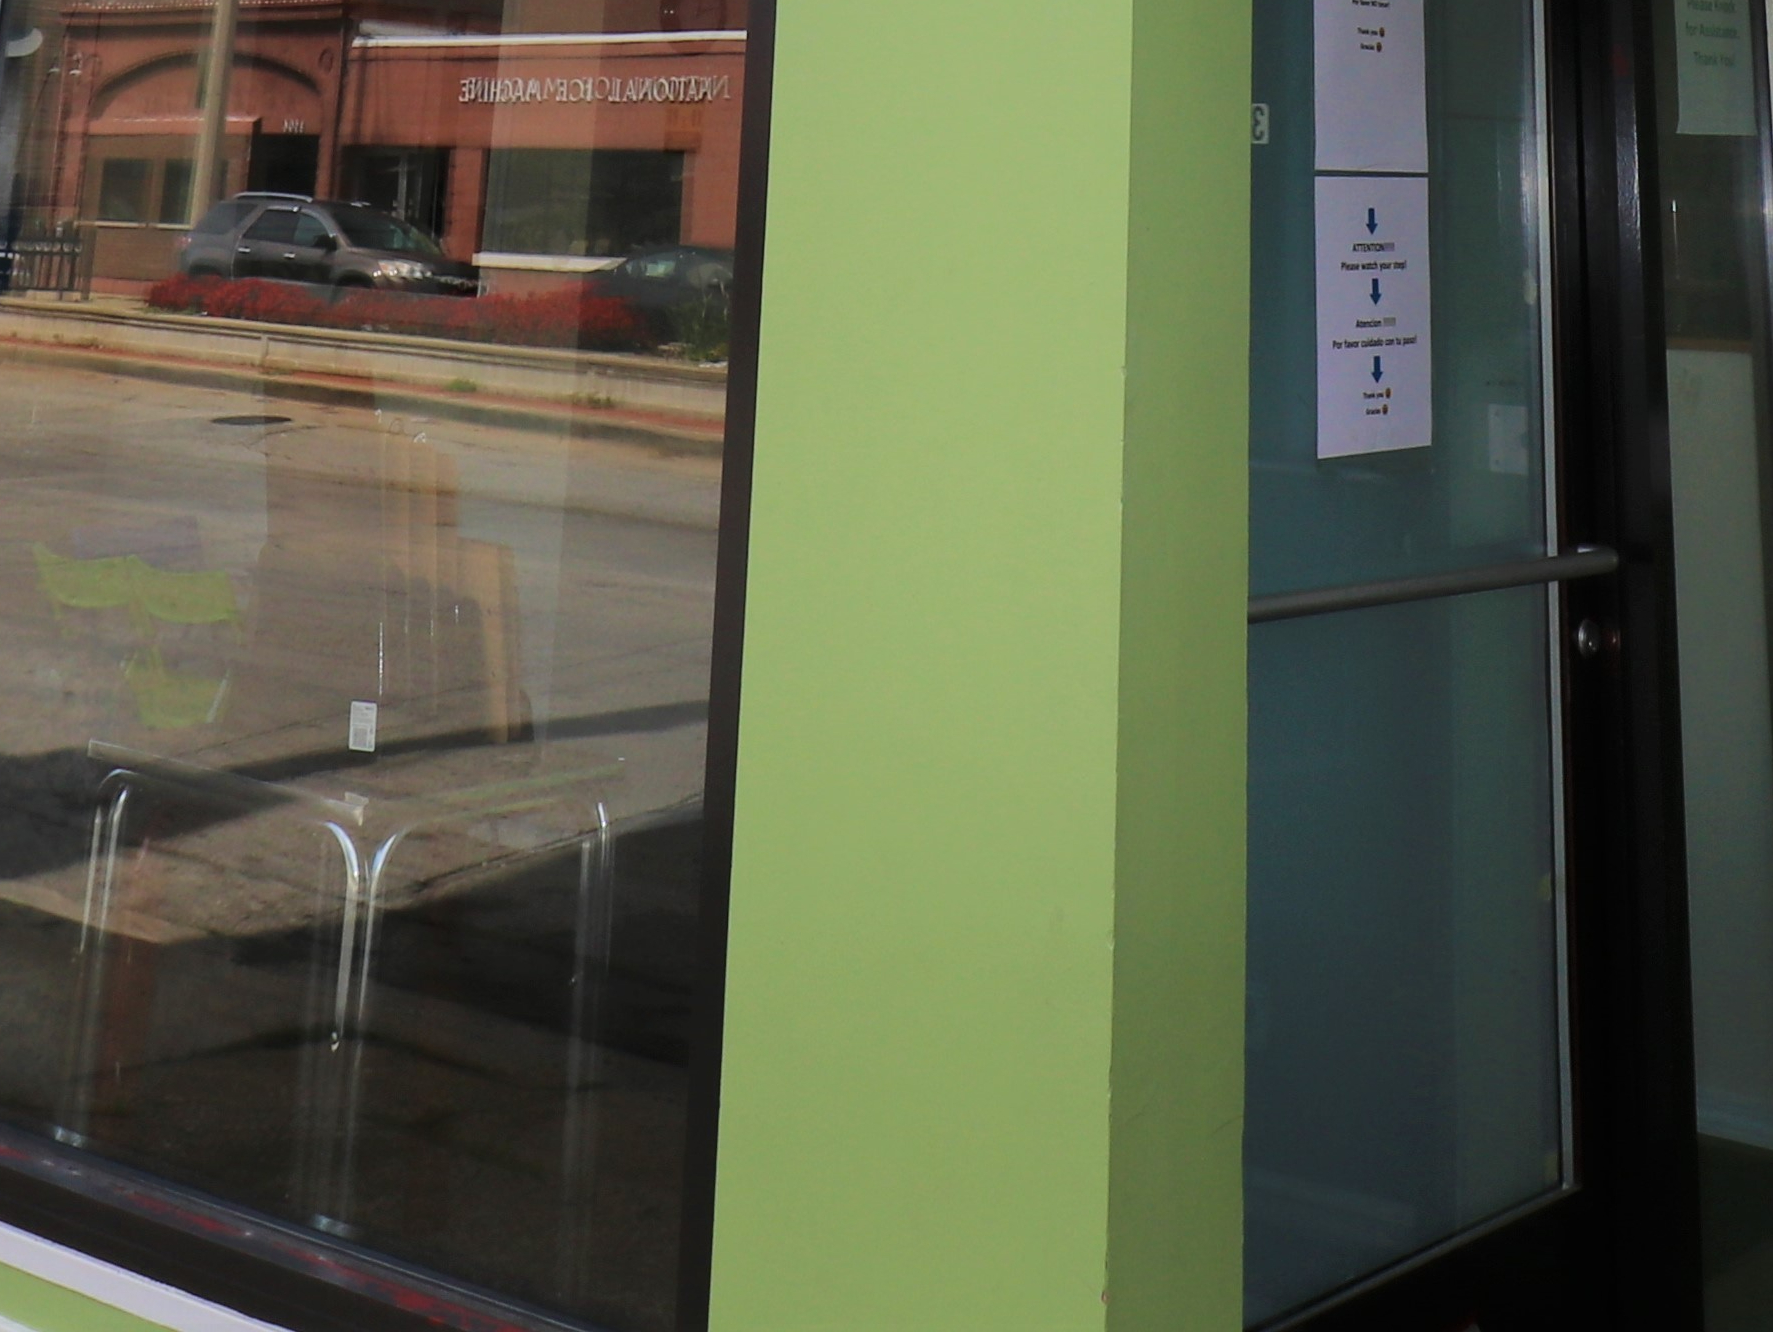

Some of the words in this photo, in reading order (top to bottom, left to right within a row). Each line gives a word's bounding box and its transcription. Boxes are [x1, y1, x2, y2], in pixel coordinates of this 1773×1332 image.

[1341, 262, 1359, 271] Please
[1361, 261, 1378, 271] watch
[1379, 262, 1392, 272] your
[1333, 339, 1343, 349] Por
[1344, 338, 1360, 349] favor
